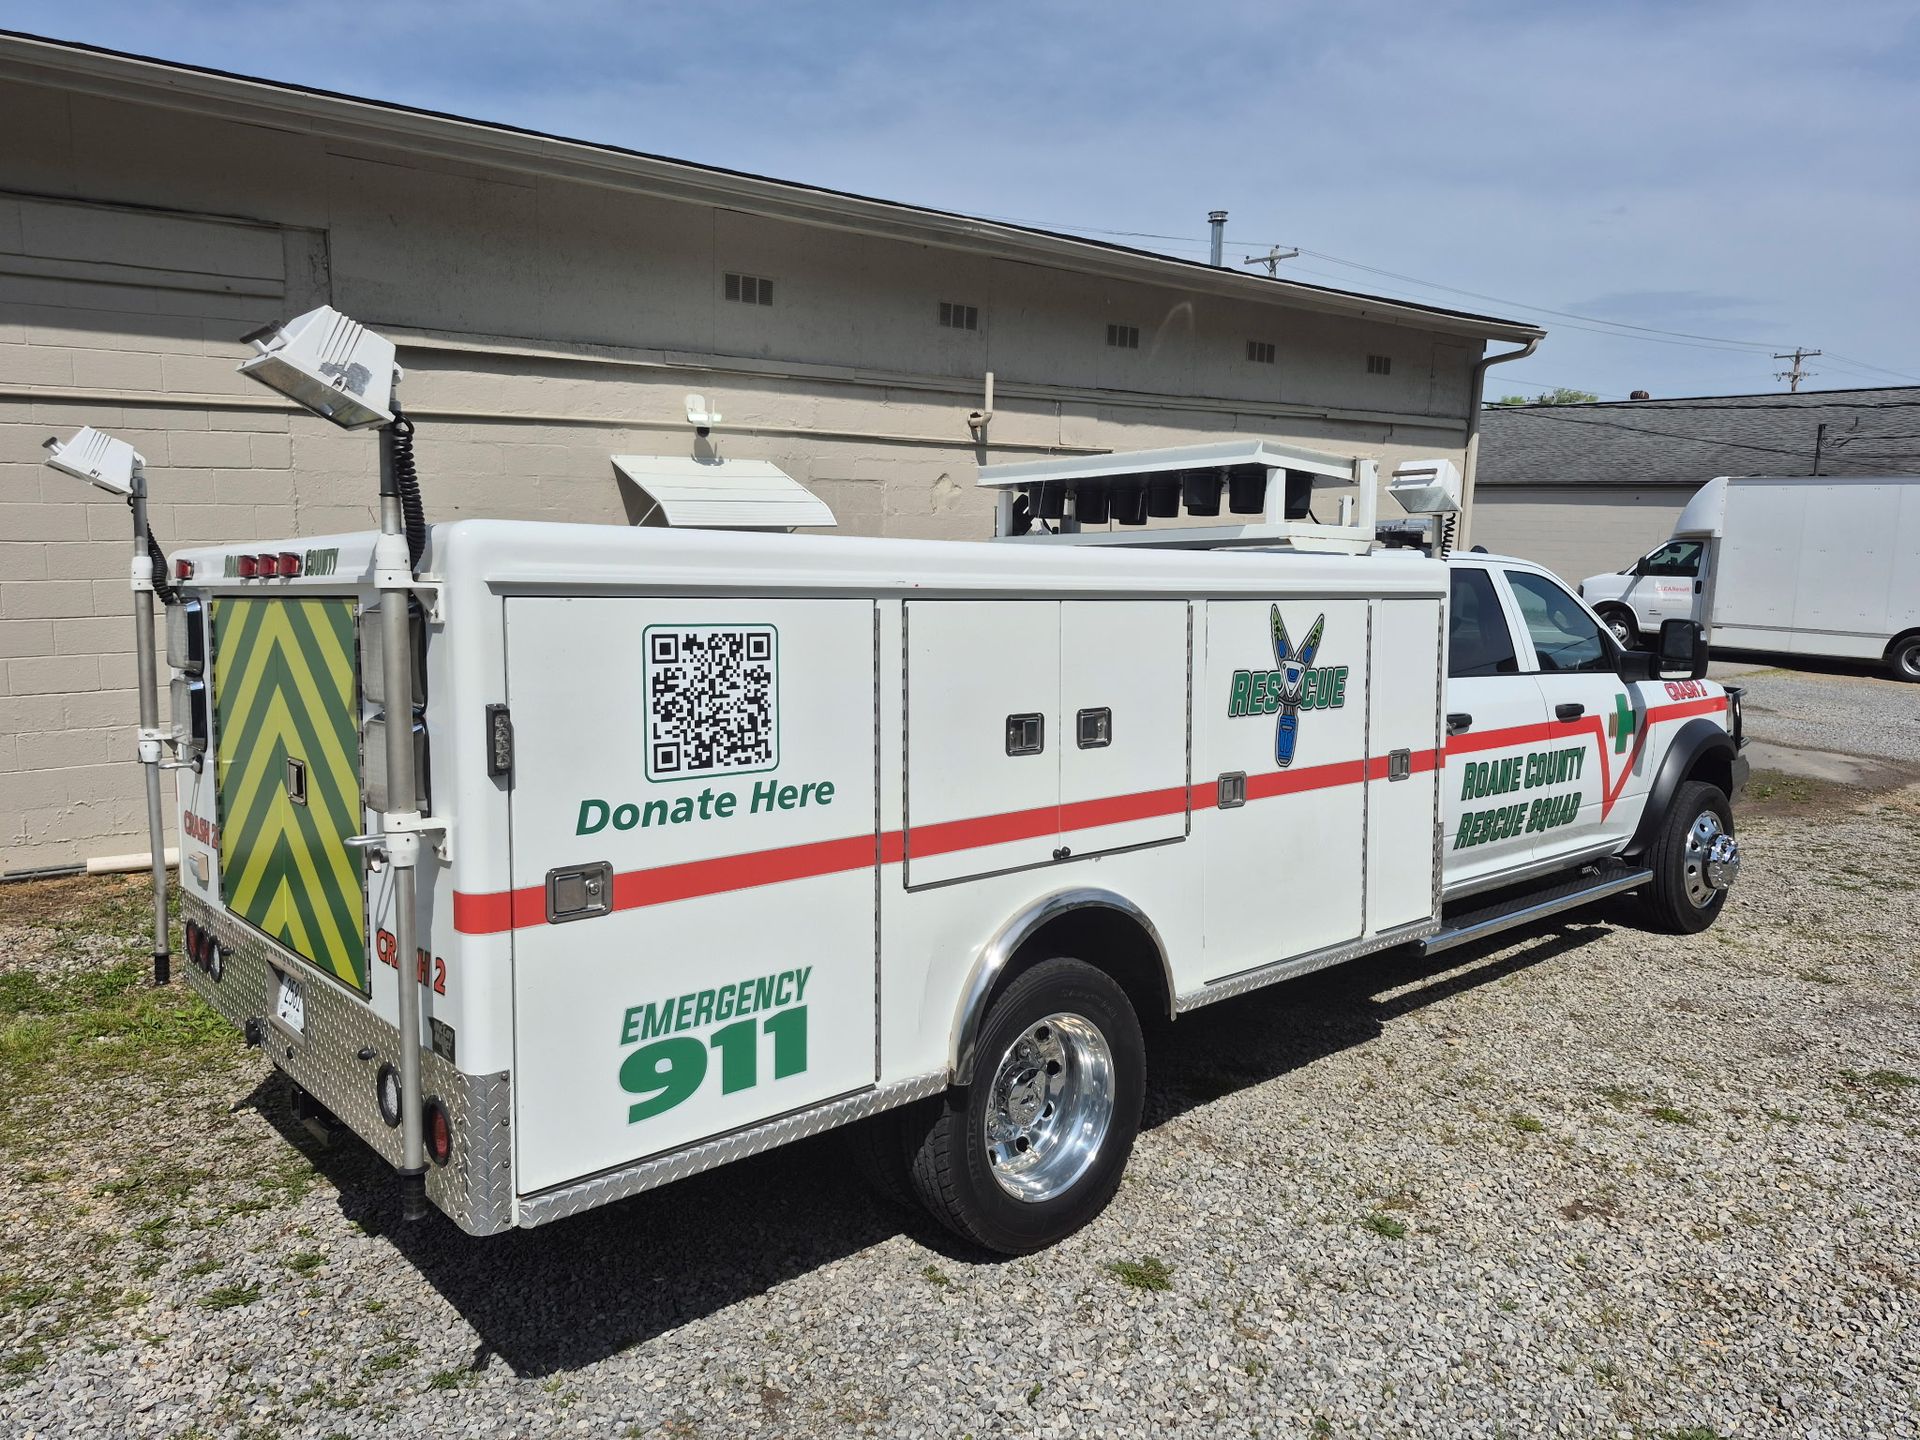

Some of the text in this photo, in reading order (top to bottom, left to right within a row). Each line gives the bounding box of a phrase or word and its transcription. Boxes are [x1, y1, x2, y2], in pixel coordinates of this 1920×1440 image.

[305, 548, 339, 576] COUNTY
[1228, 666, 1348, 717] RESCUE
[1664, 680, 1700, 701] CRASH
[1460, 746, 1586, 801] ROANE COUNTY
[184, 810, 220, 850] CRASH 2
[575, 779, 835, 836] Donate Here
[1453, 792, 1582, 850] RESCUE SQUAD
[376, 927, 446, 996] CRH 2
[620, 965, 812, 1045] EMERGENCY
[619, 1004, 807, 1125] 911
